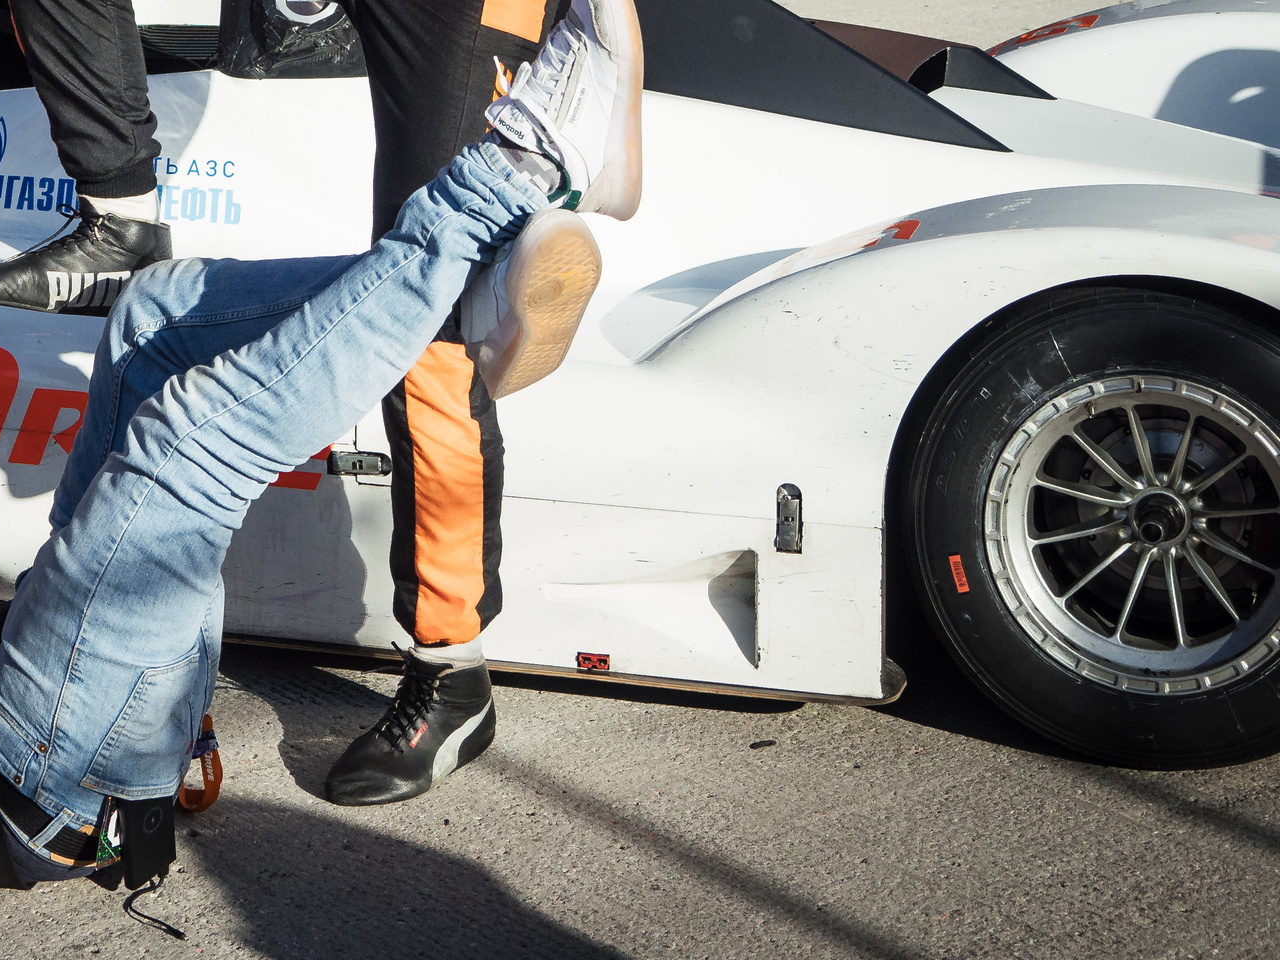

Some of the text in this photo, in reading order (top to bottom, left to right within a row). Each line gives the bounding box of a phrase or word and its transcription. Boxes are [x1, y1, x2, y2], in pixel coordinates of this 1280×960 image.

[154, 157, 236, 178] ТЬ АЗС
[46, 271, 132, 311] PUM
